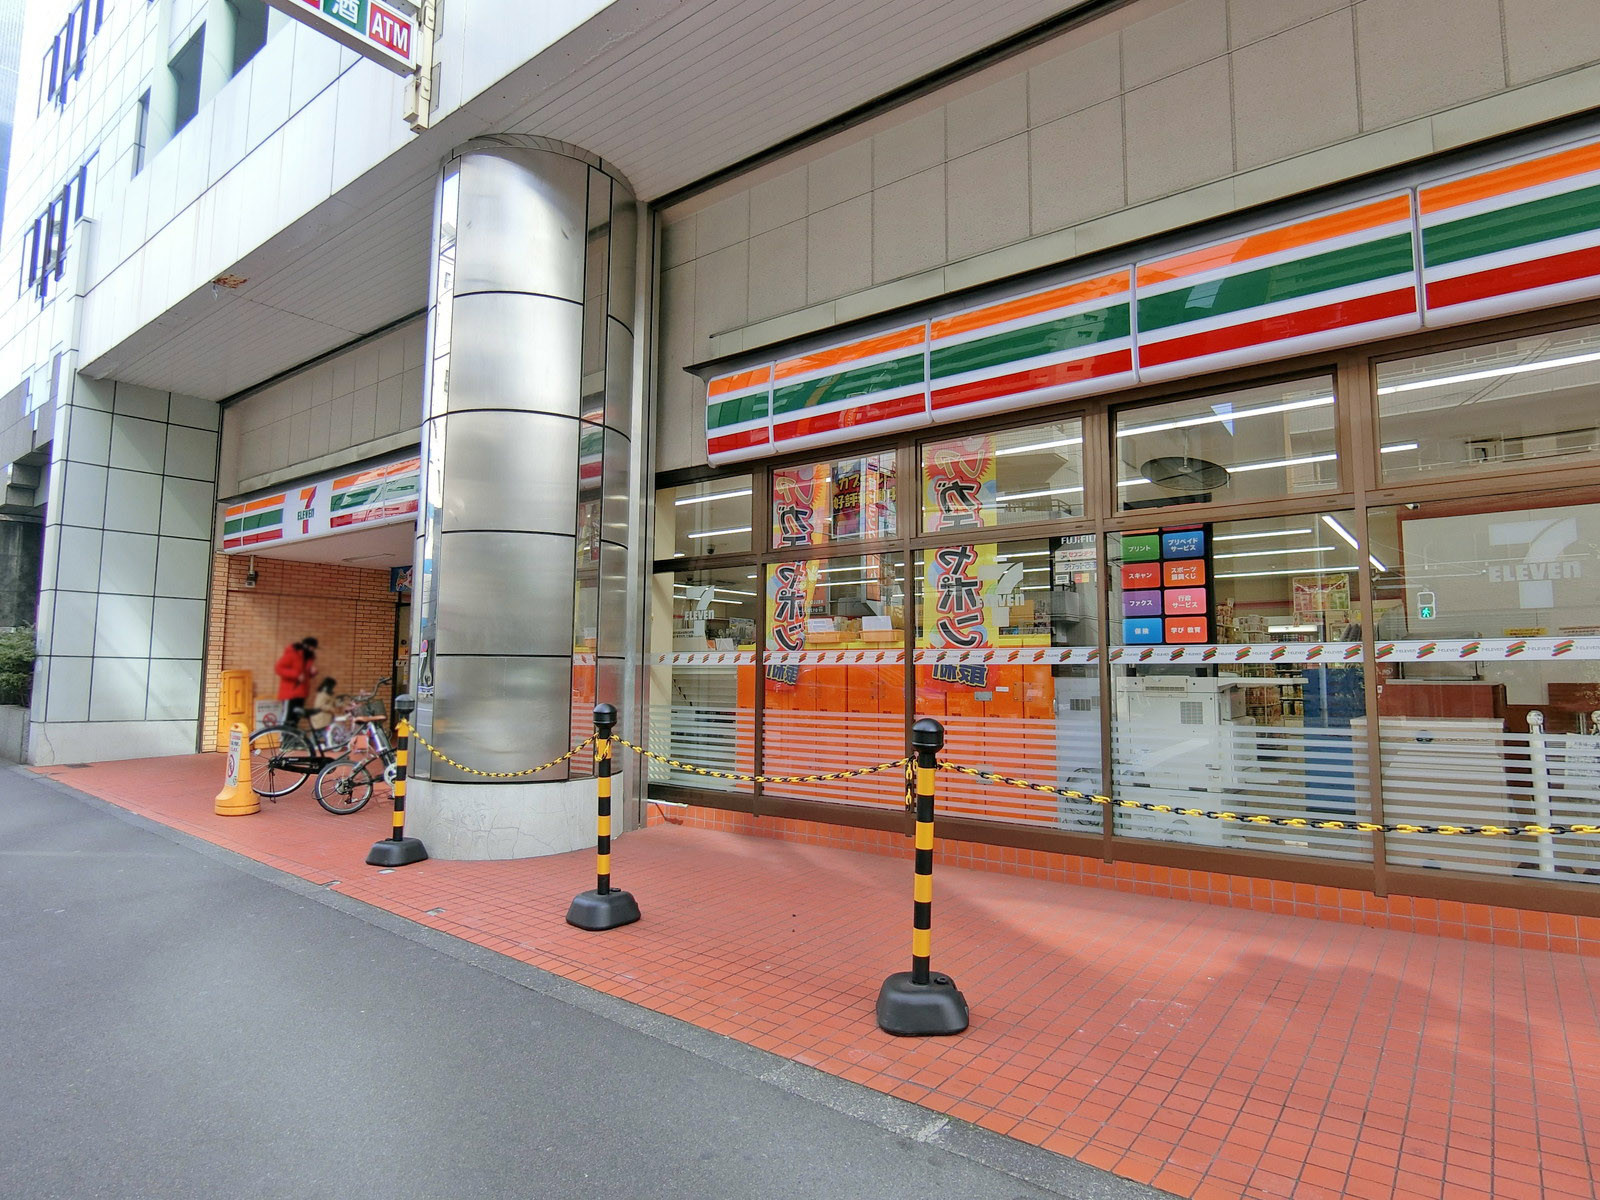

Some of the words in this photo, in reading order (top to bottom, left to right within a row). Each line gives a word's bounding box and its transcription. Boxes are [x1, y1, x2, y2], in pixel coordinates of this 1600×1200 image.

[332, 0, 361, 24] 酒
[371, 12, 409, 53] ATM
[1168, 537, 1199, 545] プリペイド
[1128, 545, 1151, 553] プリント
[1171, 566, 1197, 574] スポーツ
[1172, 601, 1198, 609] サービス
